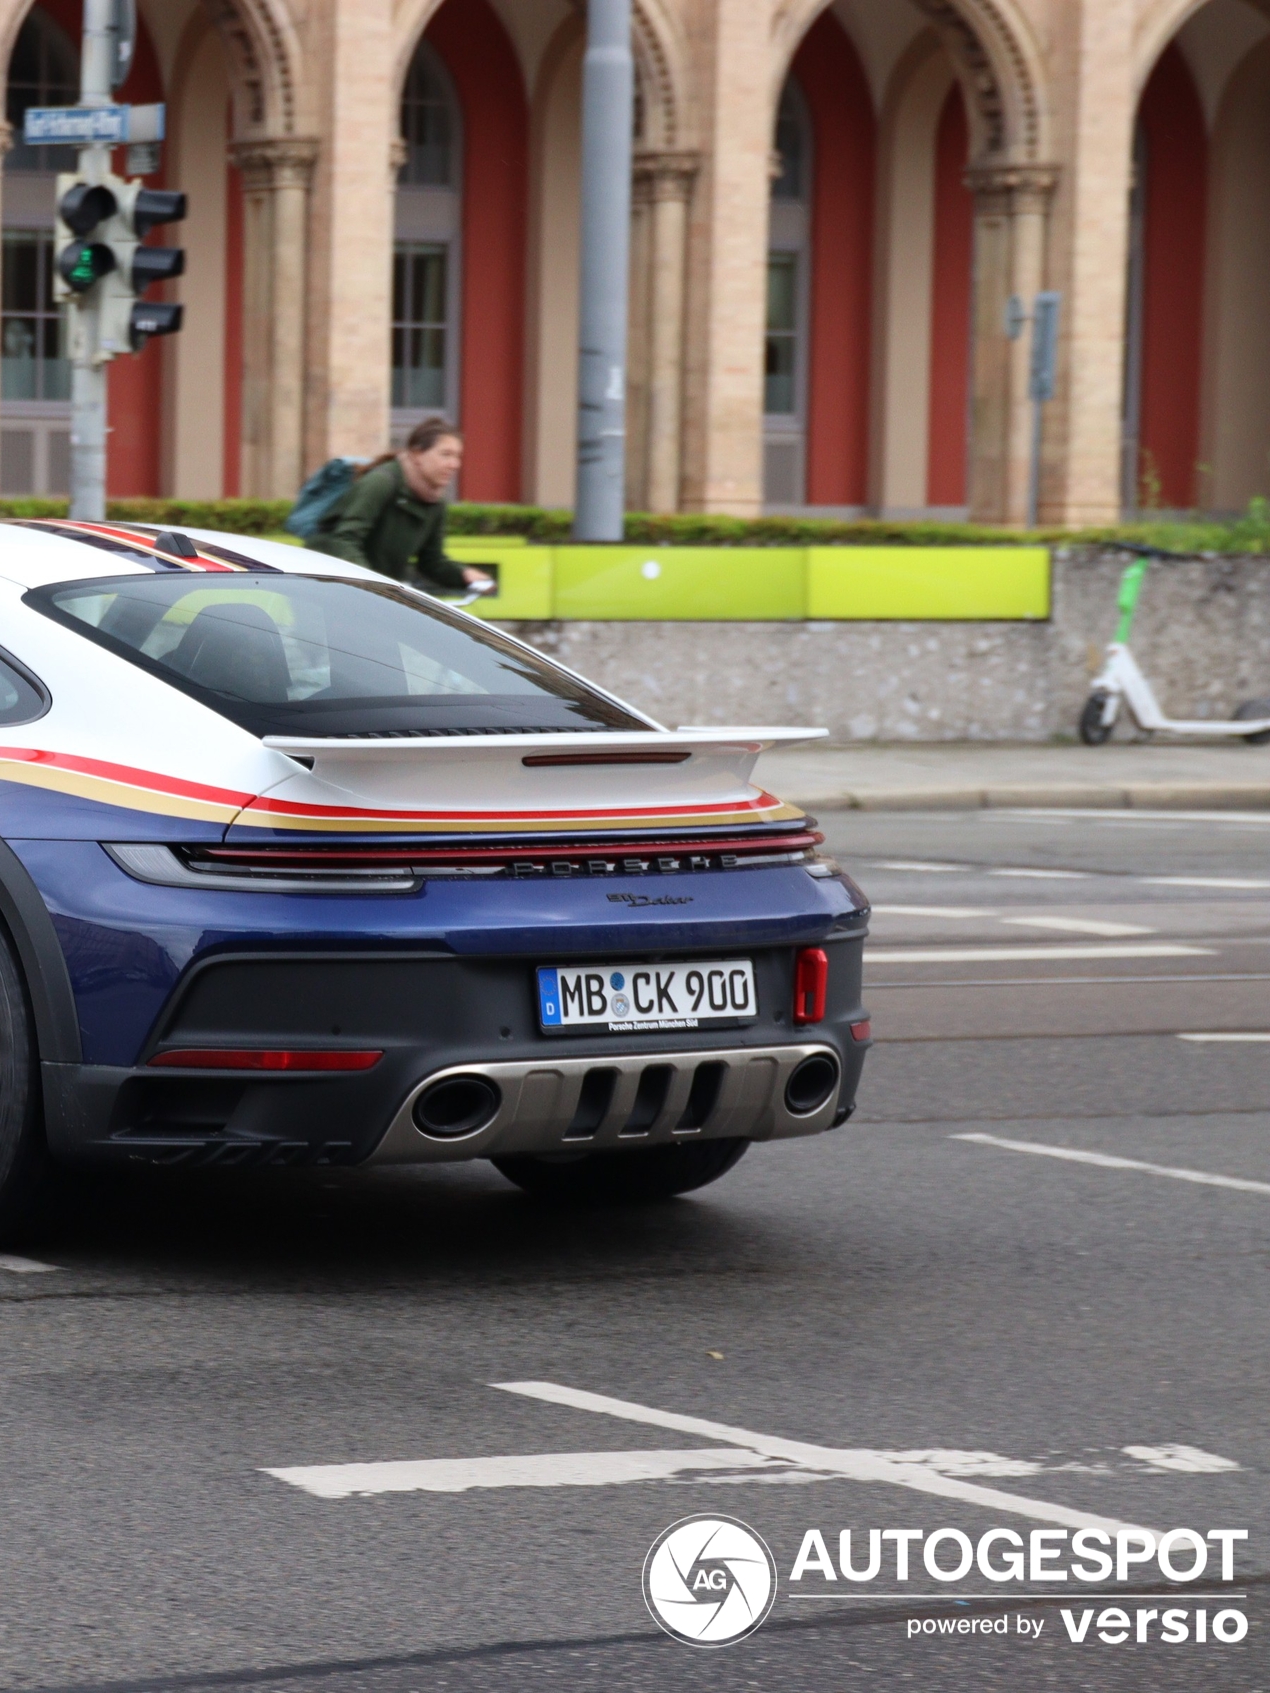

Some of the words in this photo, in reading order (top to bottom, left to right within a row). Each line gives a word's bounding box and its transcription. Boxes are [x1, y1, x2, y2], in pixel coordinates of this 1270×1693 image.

[512, 854, 738, 877] PORSCHE
[560, 973, 608, 1018] MB
[632, 971, 679, 1014] CK
[685, 969, 749, 1012] 900
[546, 1002, 555, 1016] D
[608, 1021, 633, 1031] Porsche
[633, 1020, 659, 1030] Zentrum
[659, 1019, 686, 1029] München
[686, 1018, 699, 1027] Süd
